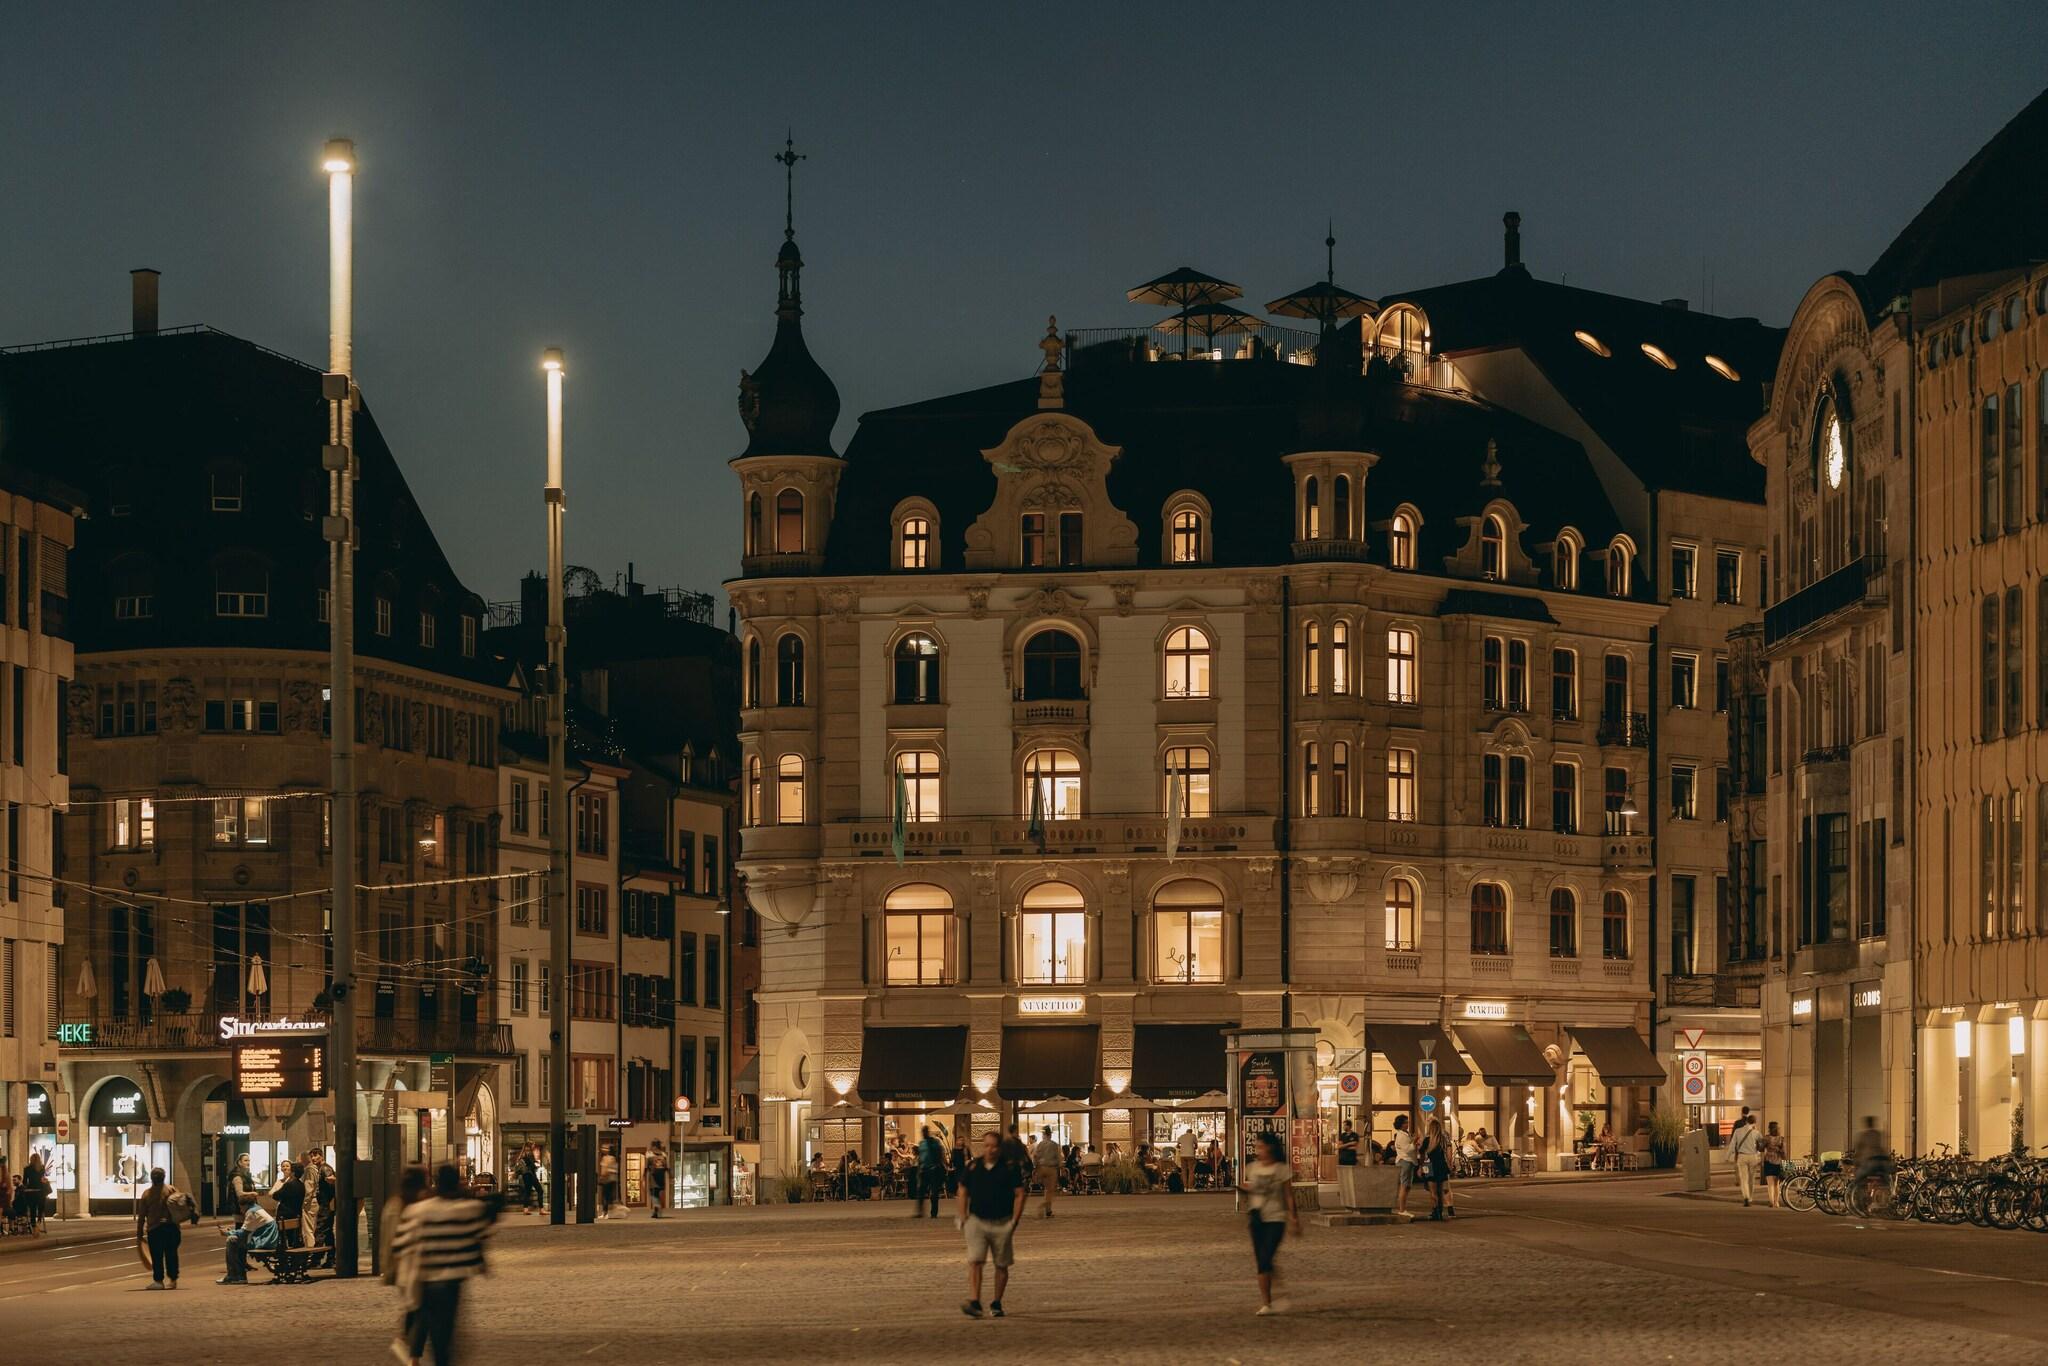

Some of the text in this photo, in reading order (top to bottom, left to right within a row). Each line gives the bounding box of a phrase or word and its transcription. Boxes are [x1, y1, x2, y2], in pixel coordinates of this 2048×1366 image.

[1854, 990, 1881, 1007] GLOBUS
[1690, 1062, 1699, 1070] 30
[217, 1125, 250, 1135] ONTB
[1246, 1119, 1264, 1132] FCB
[1272, 1119, 1286, 1132] YB
